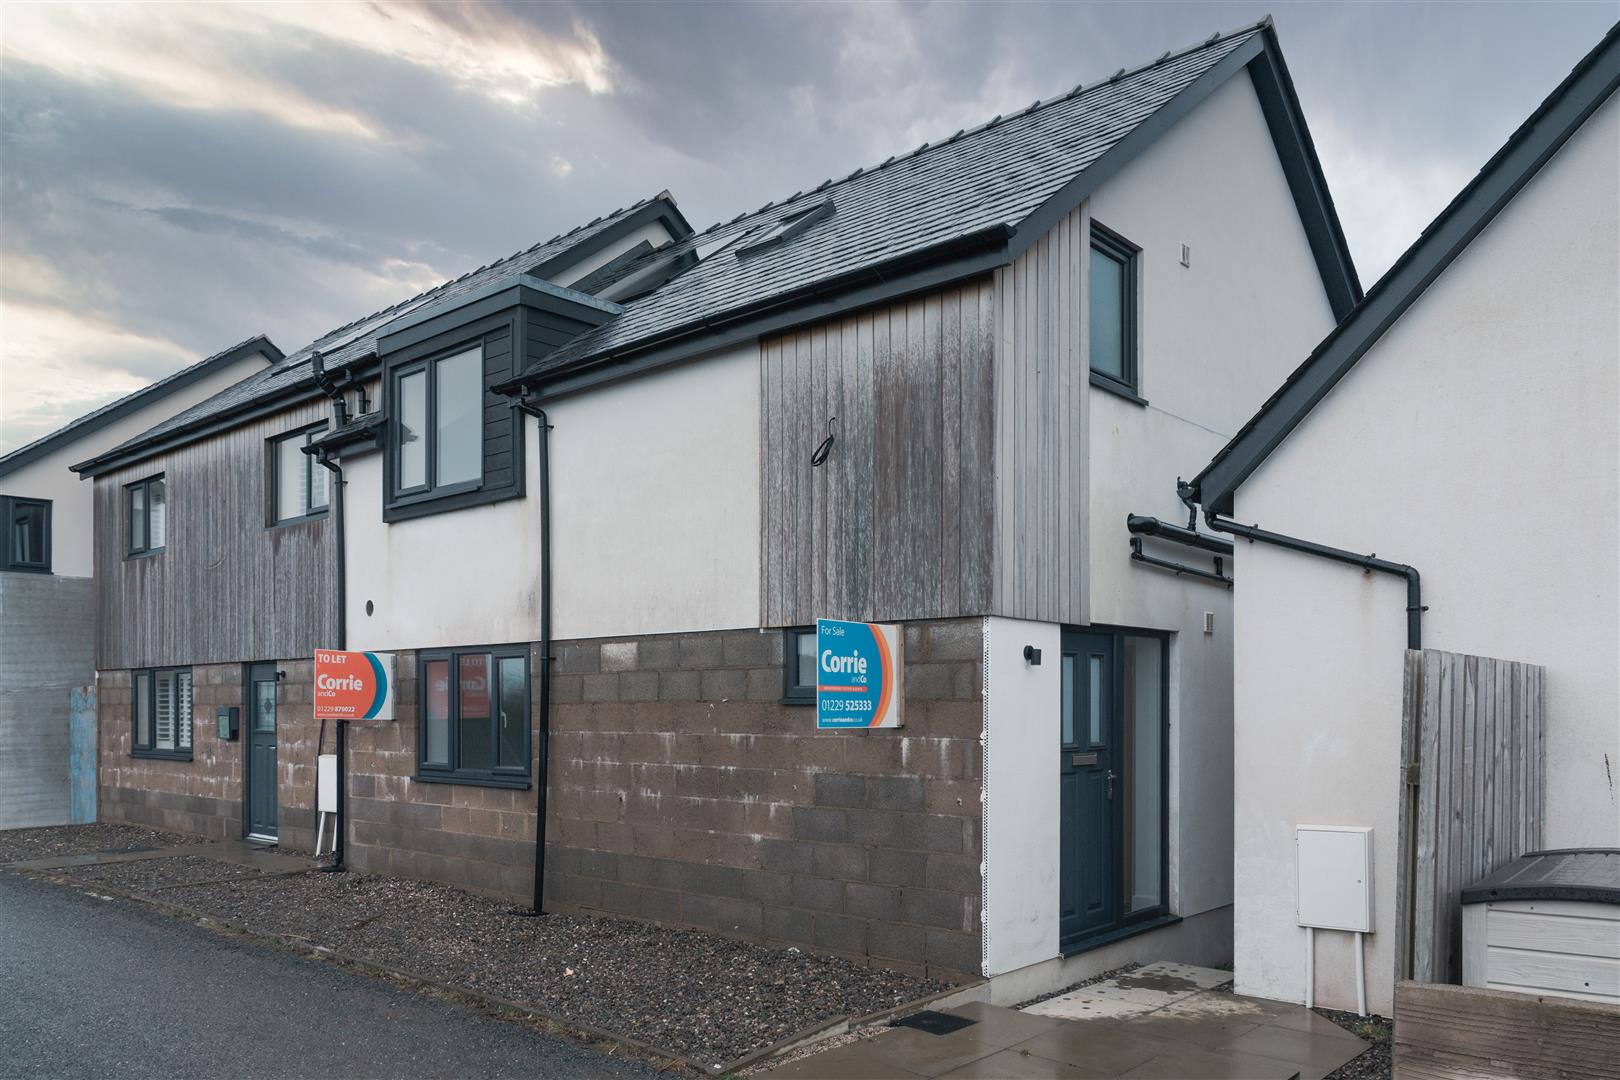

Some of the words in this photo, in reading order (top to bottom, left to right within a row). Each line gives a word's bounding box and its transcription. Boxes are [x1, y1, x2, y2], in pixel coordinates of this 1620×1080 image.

[821, 625, 832, 635] For
[833, 626, 845, 636] Sale
[317, 653, 330, 663] TO
[331, 654, 347, 664] LET
[821, 649, 867, 674] Corrie
[317, 673, 363, 691] Corrie
[821, 699, 844, 711] 01229
[845, 700, 872, 711] 525333
